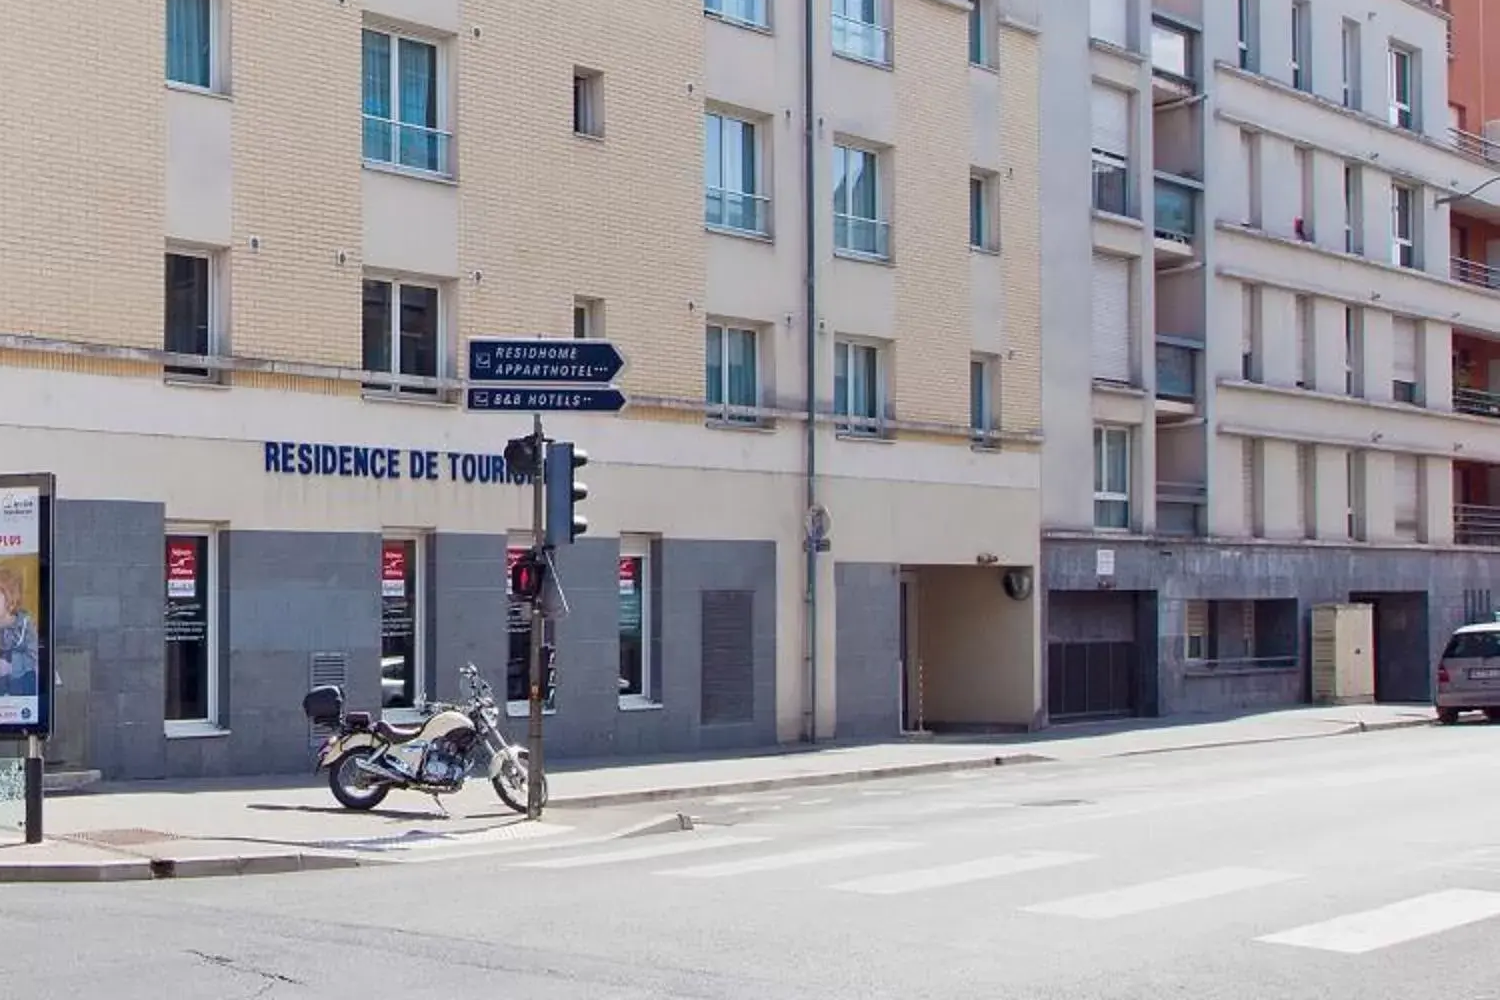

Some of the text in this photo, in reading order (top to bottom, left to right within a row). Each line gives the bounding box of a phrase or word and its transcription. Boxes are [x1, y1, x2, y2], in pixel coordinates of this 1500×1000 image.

[495, 347, 578, 360] RESIDHOME
[493, 393, 581, 407] B&B HOTELS
[265, 441, 400, 480] RESIDENCE
[409, 450, 439, 481] DE
